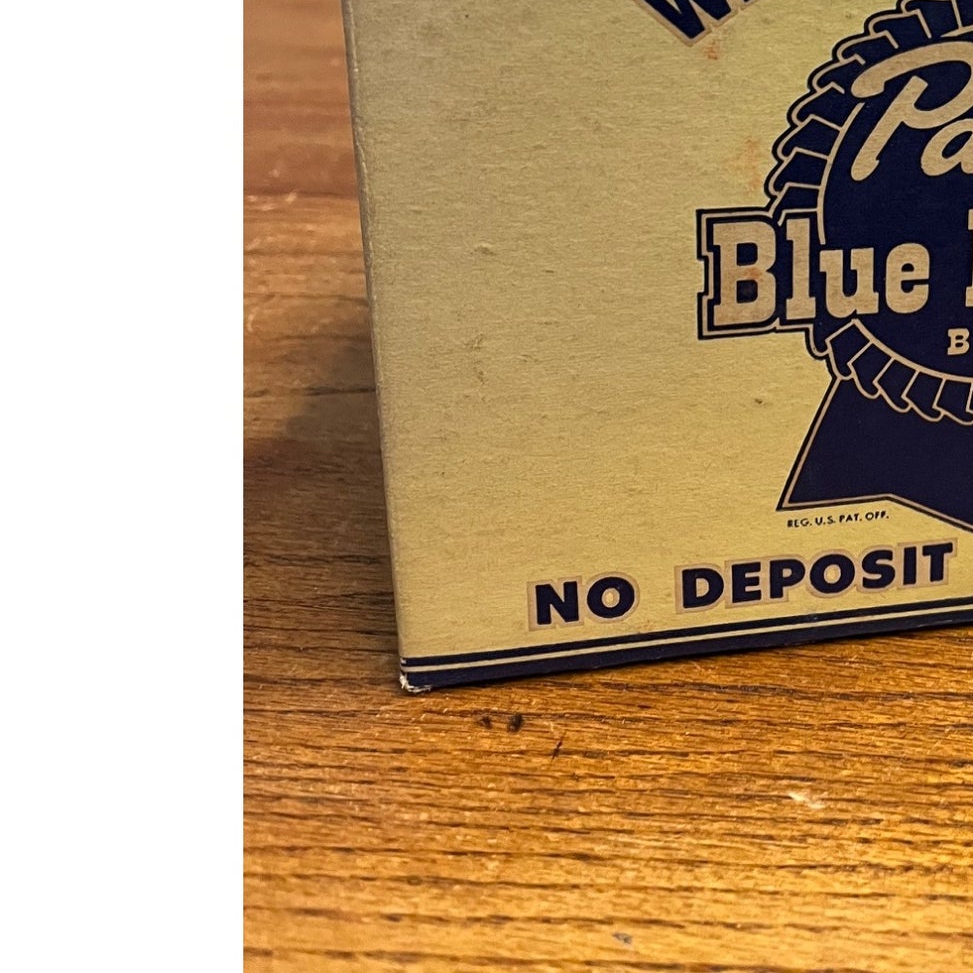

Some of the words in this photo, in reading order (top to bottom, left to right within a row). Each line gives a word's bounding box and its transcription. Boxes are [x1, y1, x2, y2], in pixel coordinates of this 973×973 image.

[712, 211, 930, 327] Blue
[814, 516, 836, 526] U.S.
[839, 513, 862, 523] PAT.
[865, 510, 889, 521] OFF.
[534, 576, 636, 625] NO
[681, 541, 954, 609] DEPOSIT
